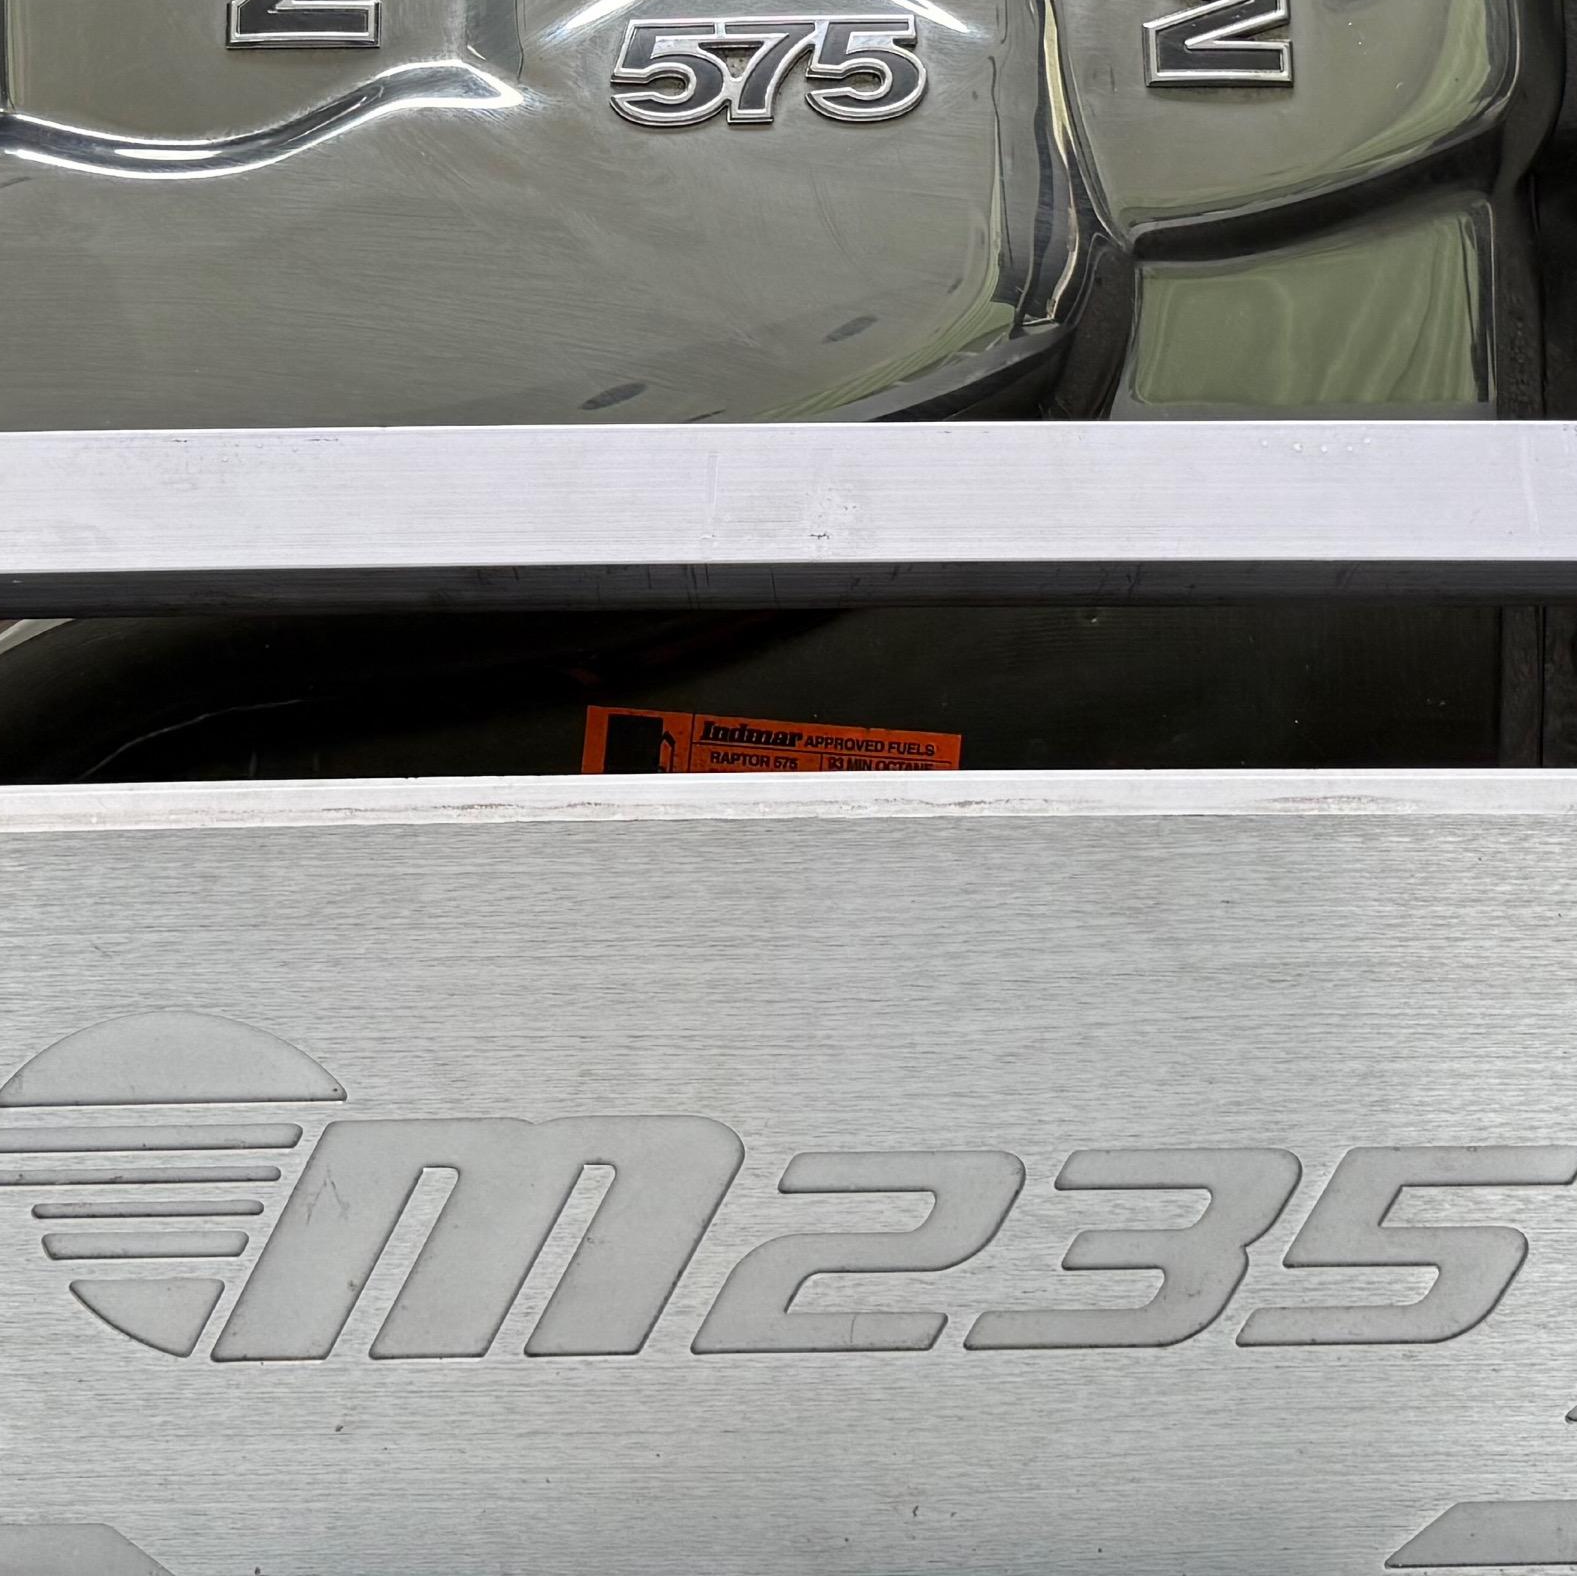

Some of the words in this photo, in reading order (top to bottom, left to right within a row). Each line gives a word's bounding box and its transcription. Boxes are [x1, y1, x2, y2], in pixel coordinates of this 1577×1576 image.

[609, 14, 928, 126] 575
[699, 720, 803, 747] Indmar
[804, 735, 885, 754] APPROVED
[887, 741, 936, 757] FUELS
[710, 751, 771, 768] RAPTOR
[846, 757, 873, 771] MIN
